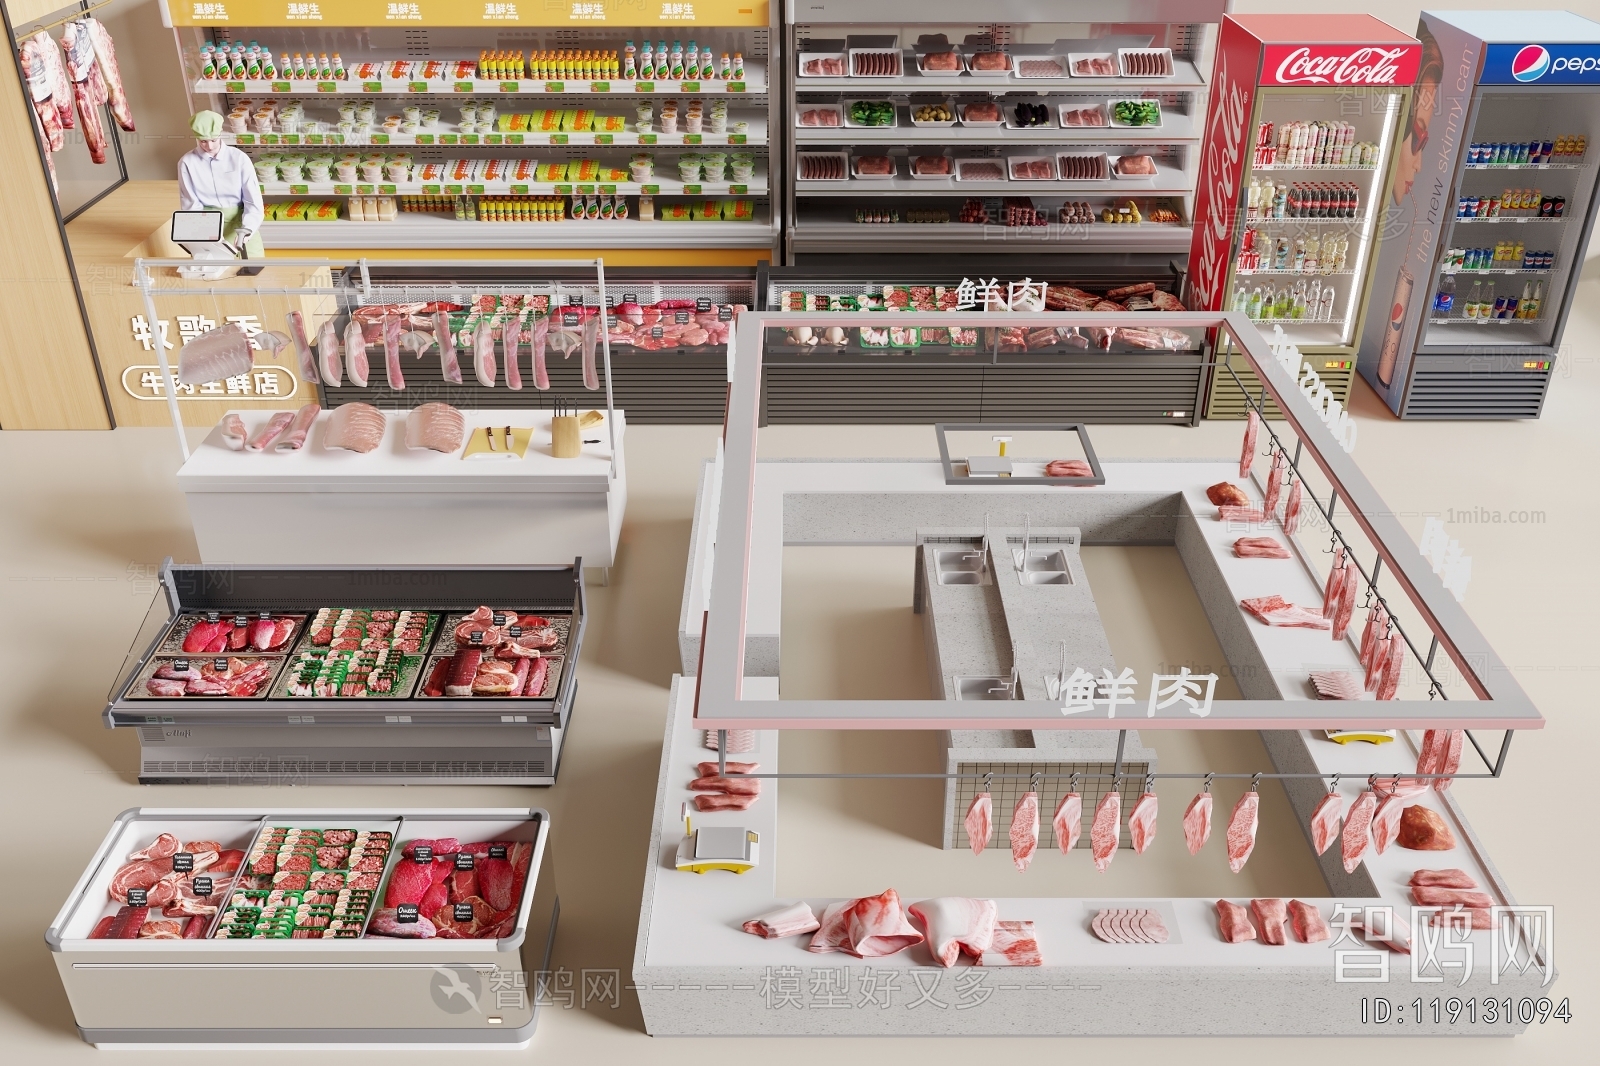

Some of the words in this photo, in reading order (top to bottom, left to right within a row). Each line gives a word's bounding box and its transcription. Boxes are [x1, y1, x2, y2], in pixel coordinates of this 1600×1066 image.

[1275, 47, 1410, 84] Coca-Cola
[1416, 229, 1432, 263] the
[1426, 177, 1444, 225] new
[1438, 98, 1463, 173] skinny
[1456, 46, 1474, 92] can
[954, 277, 1049, 312] 鲜肉
[1061, 667, 1219, 718] 鲜肉
